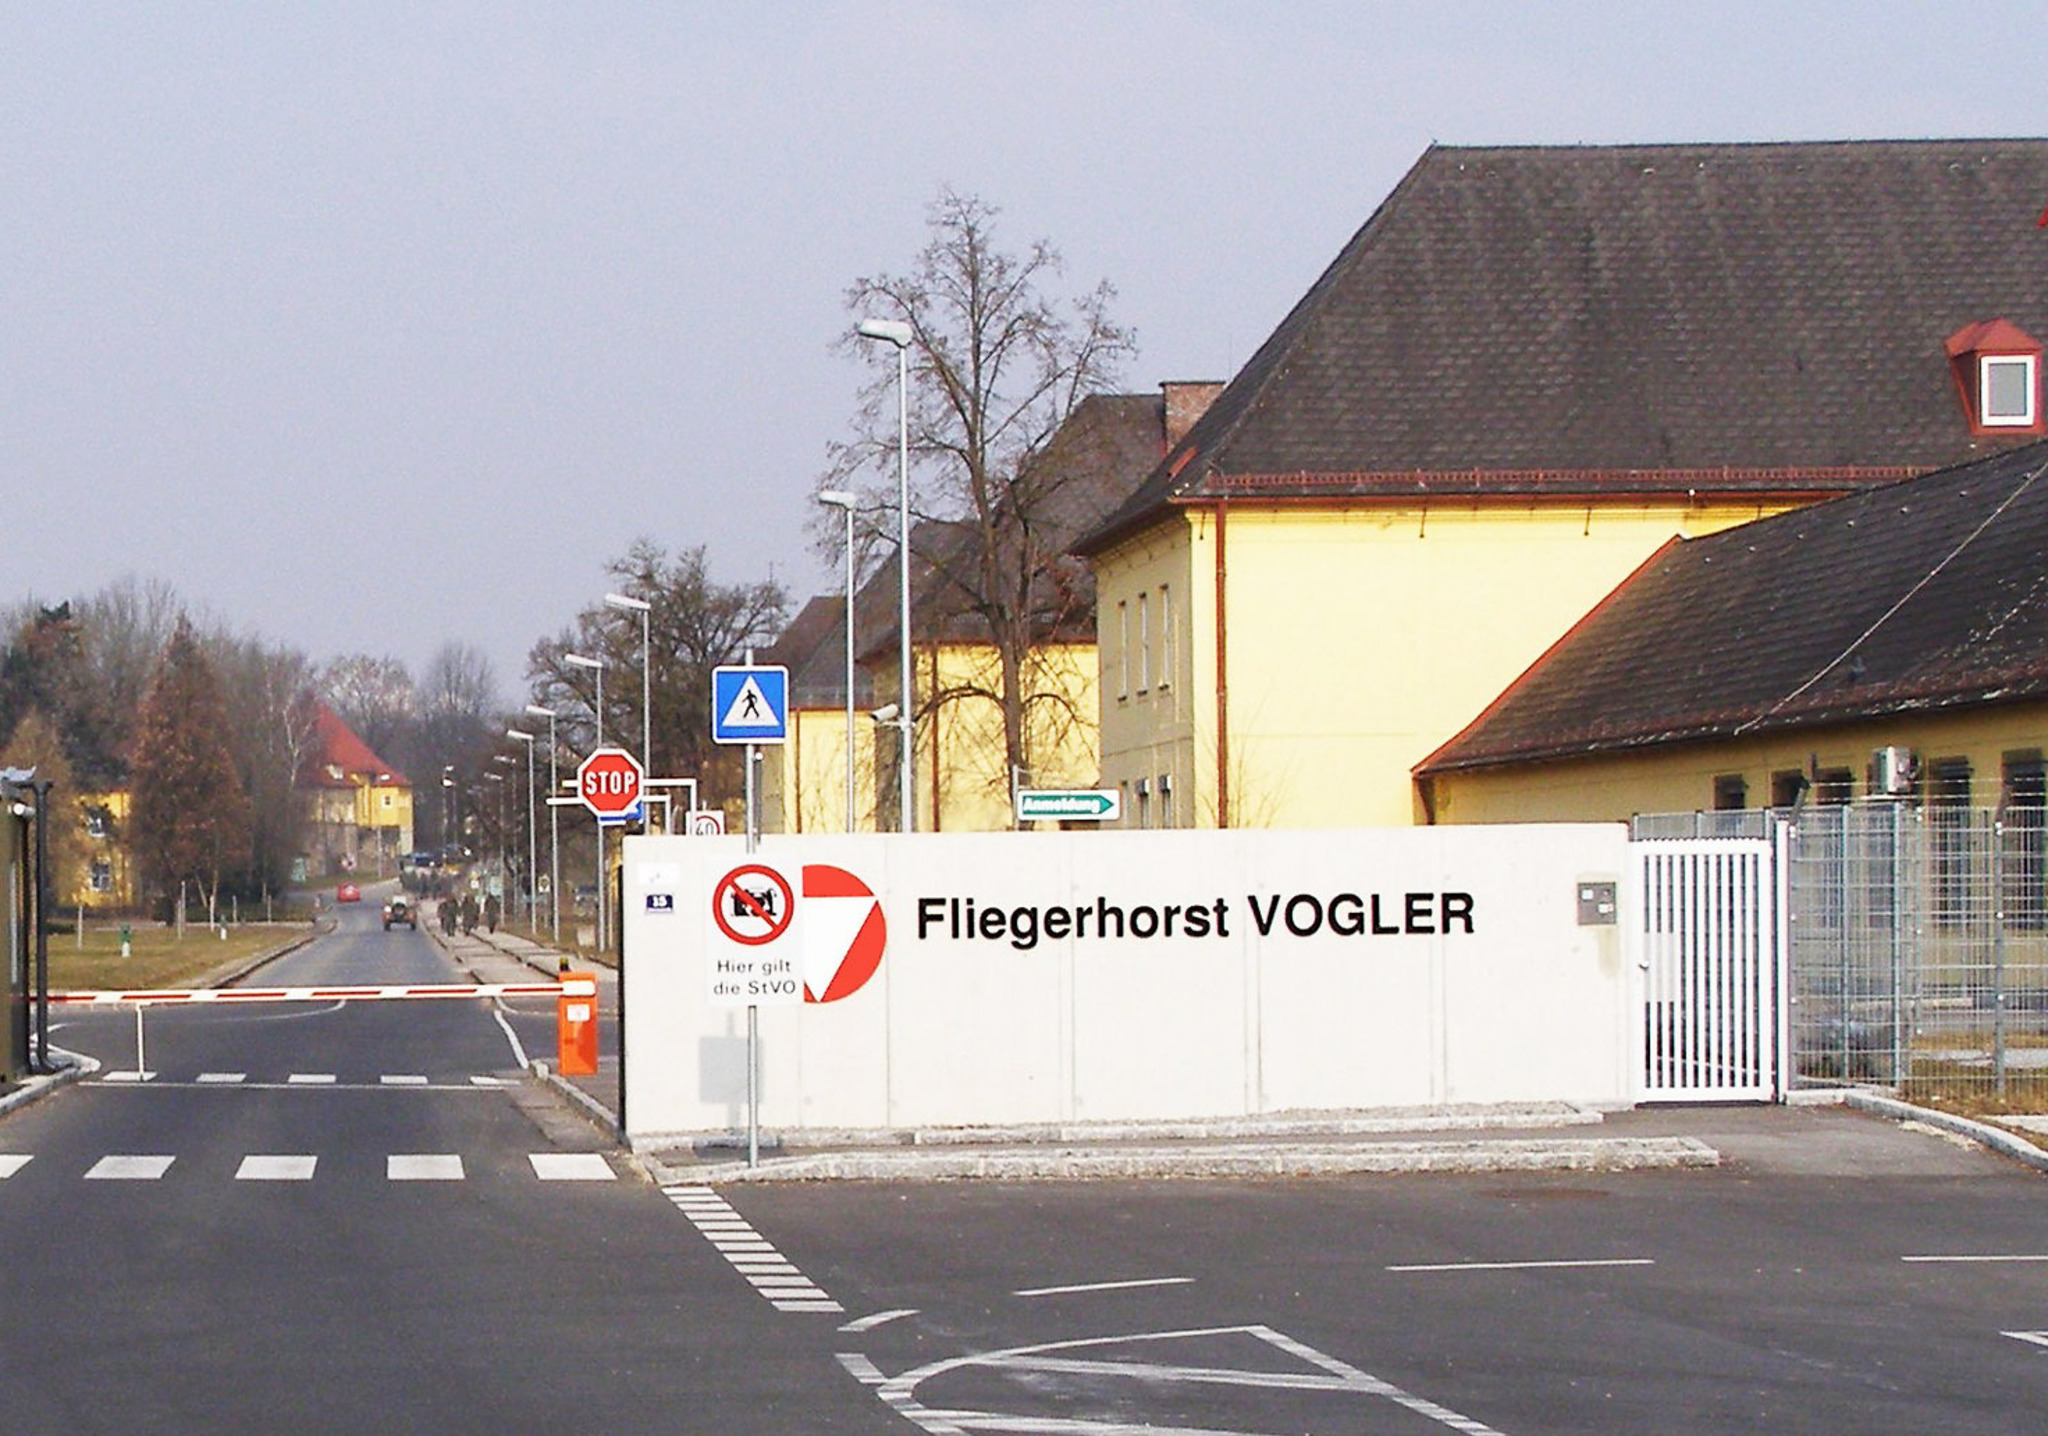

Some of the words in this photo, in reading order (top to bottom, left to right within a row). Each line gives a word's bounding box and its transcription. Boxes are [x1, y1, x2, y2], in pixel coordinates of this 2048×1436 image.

[585, 772, 636, 796] STOP
[917, 897, 1229, 949] Fliegerhorst
[1248, 892, 1475, 937] VOGLER
[717, 959, 755, 973] Hier
[762, 959, 791, 976] gilt
[713, 981, 741, 994] die
[748, 980, 796, 994] StVO
